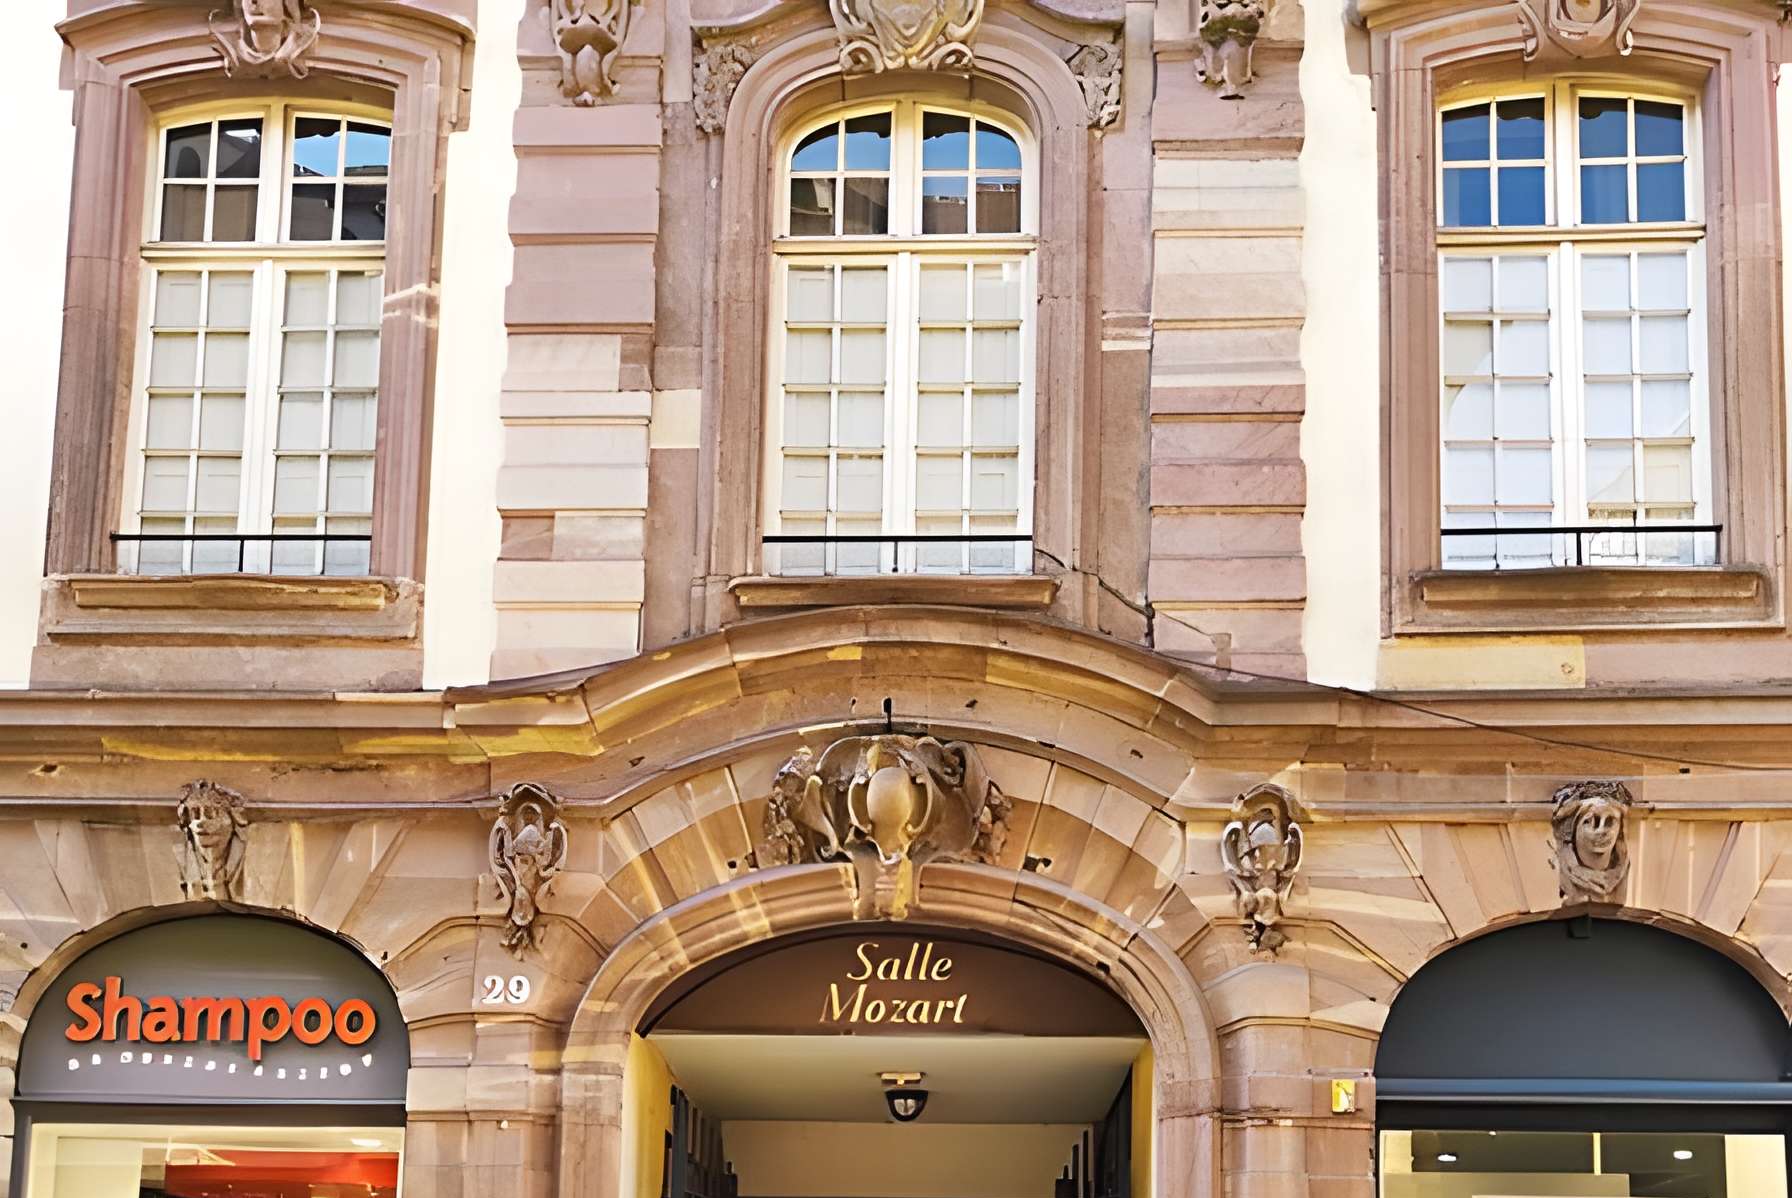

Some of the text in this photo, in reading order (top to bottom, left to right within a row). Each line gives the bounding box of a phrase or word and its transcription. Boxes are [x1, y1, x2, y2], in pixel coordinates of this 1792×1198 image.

[846, 942, 952, 980] Salle
[480, 975, 530, 1004] 29
[819, 983, 968, 1024] Mozart
[65, 976, 376, 1061] Shampoo
